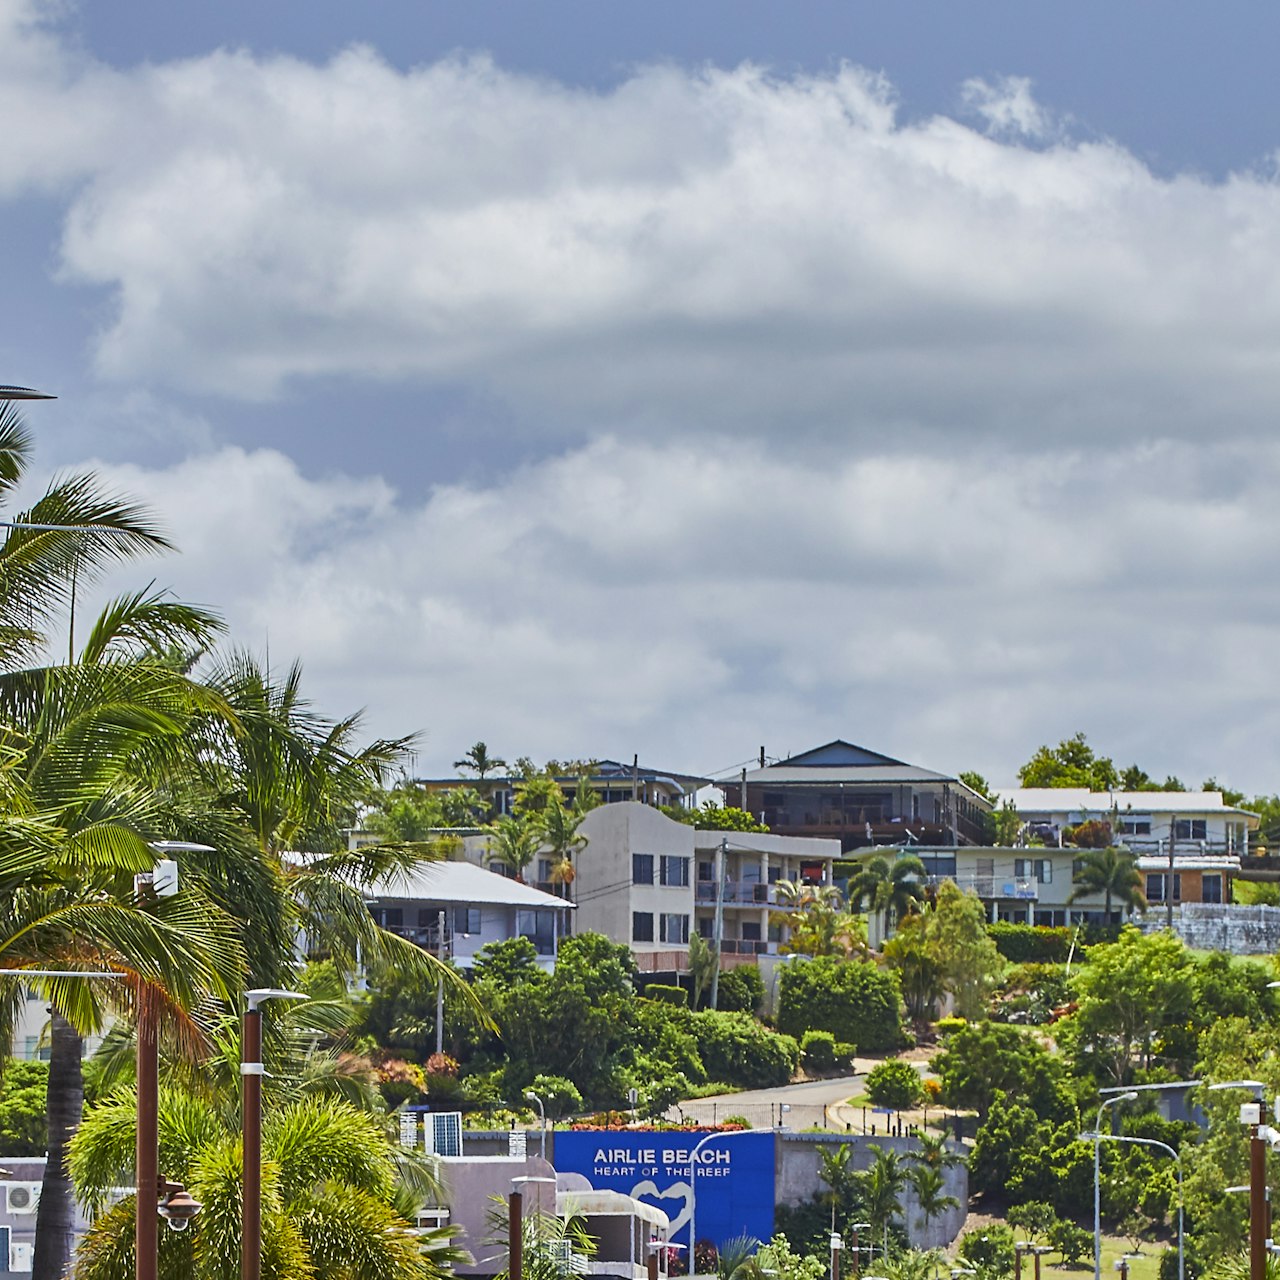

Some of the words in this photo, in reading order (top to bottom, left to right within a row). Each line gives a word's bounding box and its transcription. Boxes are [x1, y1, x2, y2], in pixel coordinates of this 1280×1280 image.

[594, 1149, 656, 1163] AIRLIE
[662, 1149, 731, 1164] BEACH
[594, 1167, 635, 1176] HEART
[642, 1167, 658, 1176] OF
[666, 1167, 691, 1176] THE
[697, 1167, 731, 1176] REEF
